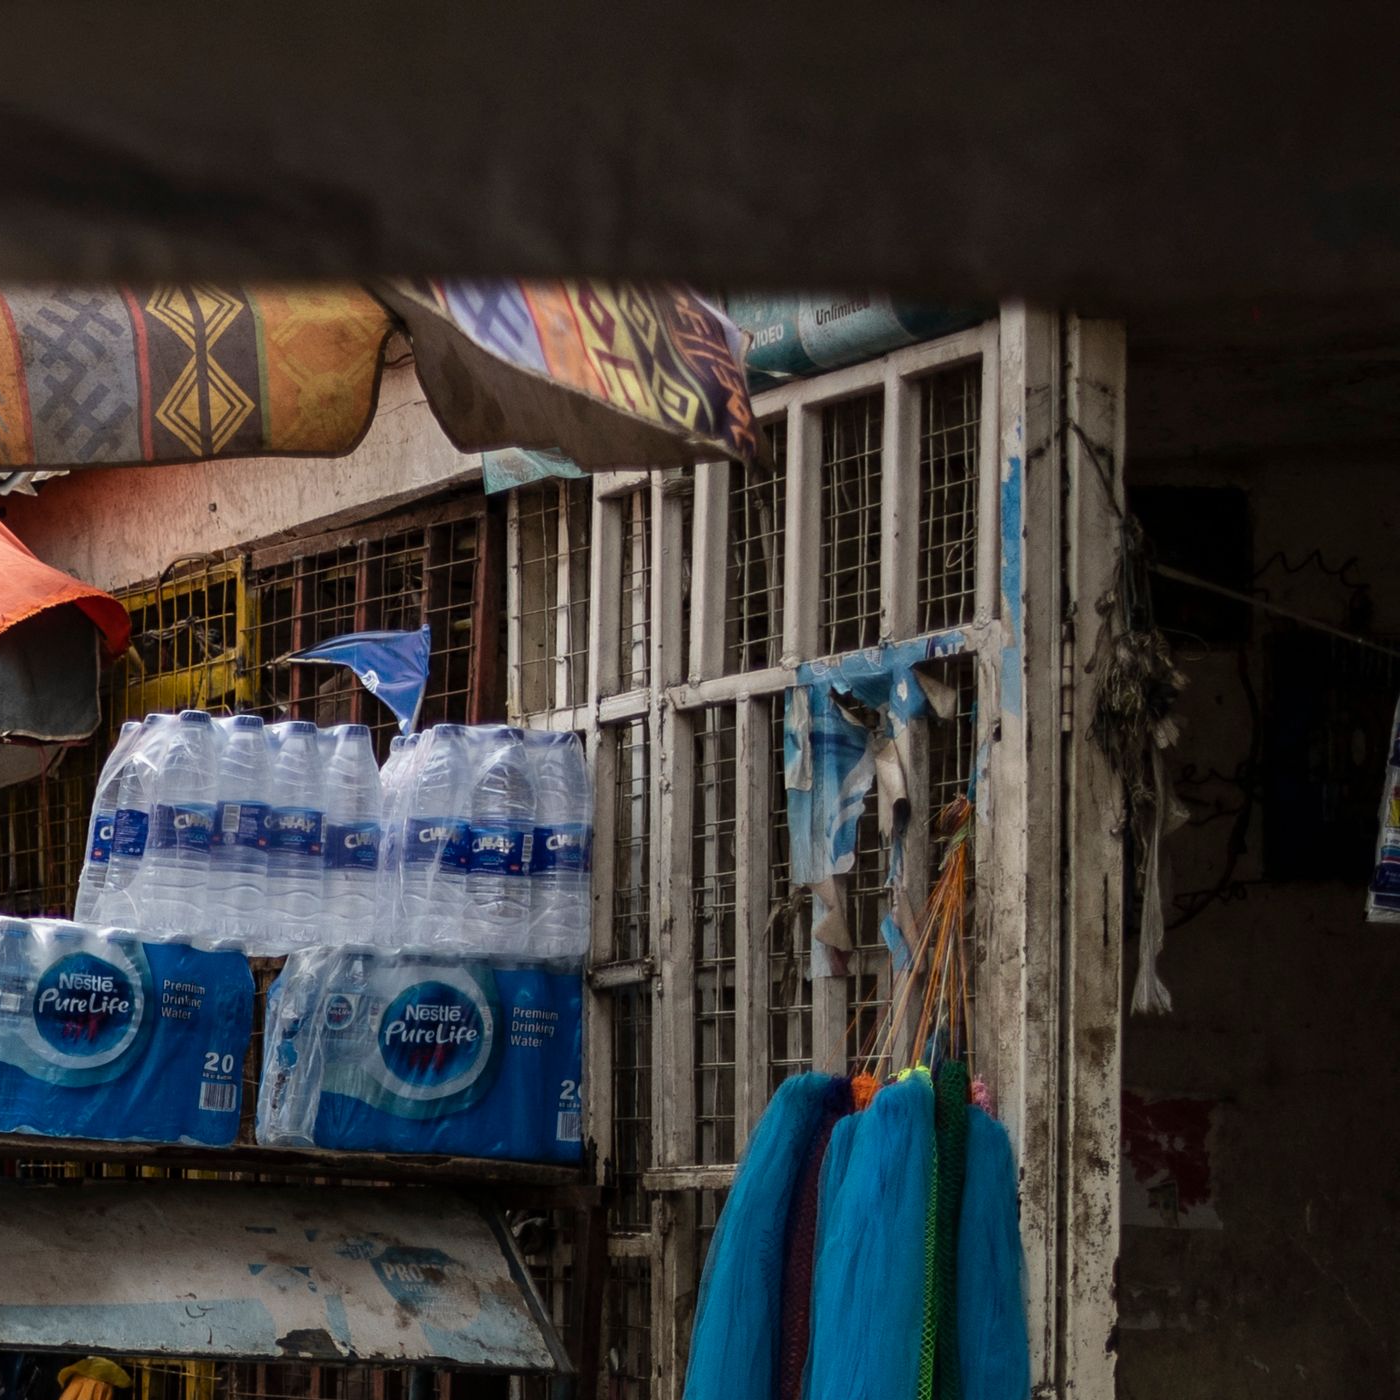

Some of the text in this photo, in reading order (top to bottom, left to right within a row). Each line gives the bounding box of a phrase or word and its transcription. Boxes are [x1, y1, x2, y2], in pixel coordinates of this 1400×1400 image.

[163, 979, 206, 995] Premium
[160, 1006, 192, 1020] Water
[512, 1006, 559, 1022] Premium
[511, 1020, 555, 1037] Drinking
[510, 1035, 543, 1049] Water
[203, 1052, 235, 1074] 20
